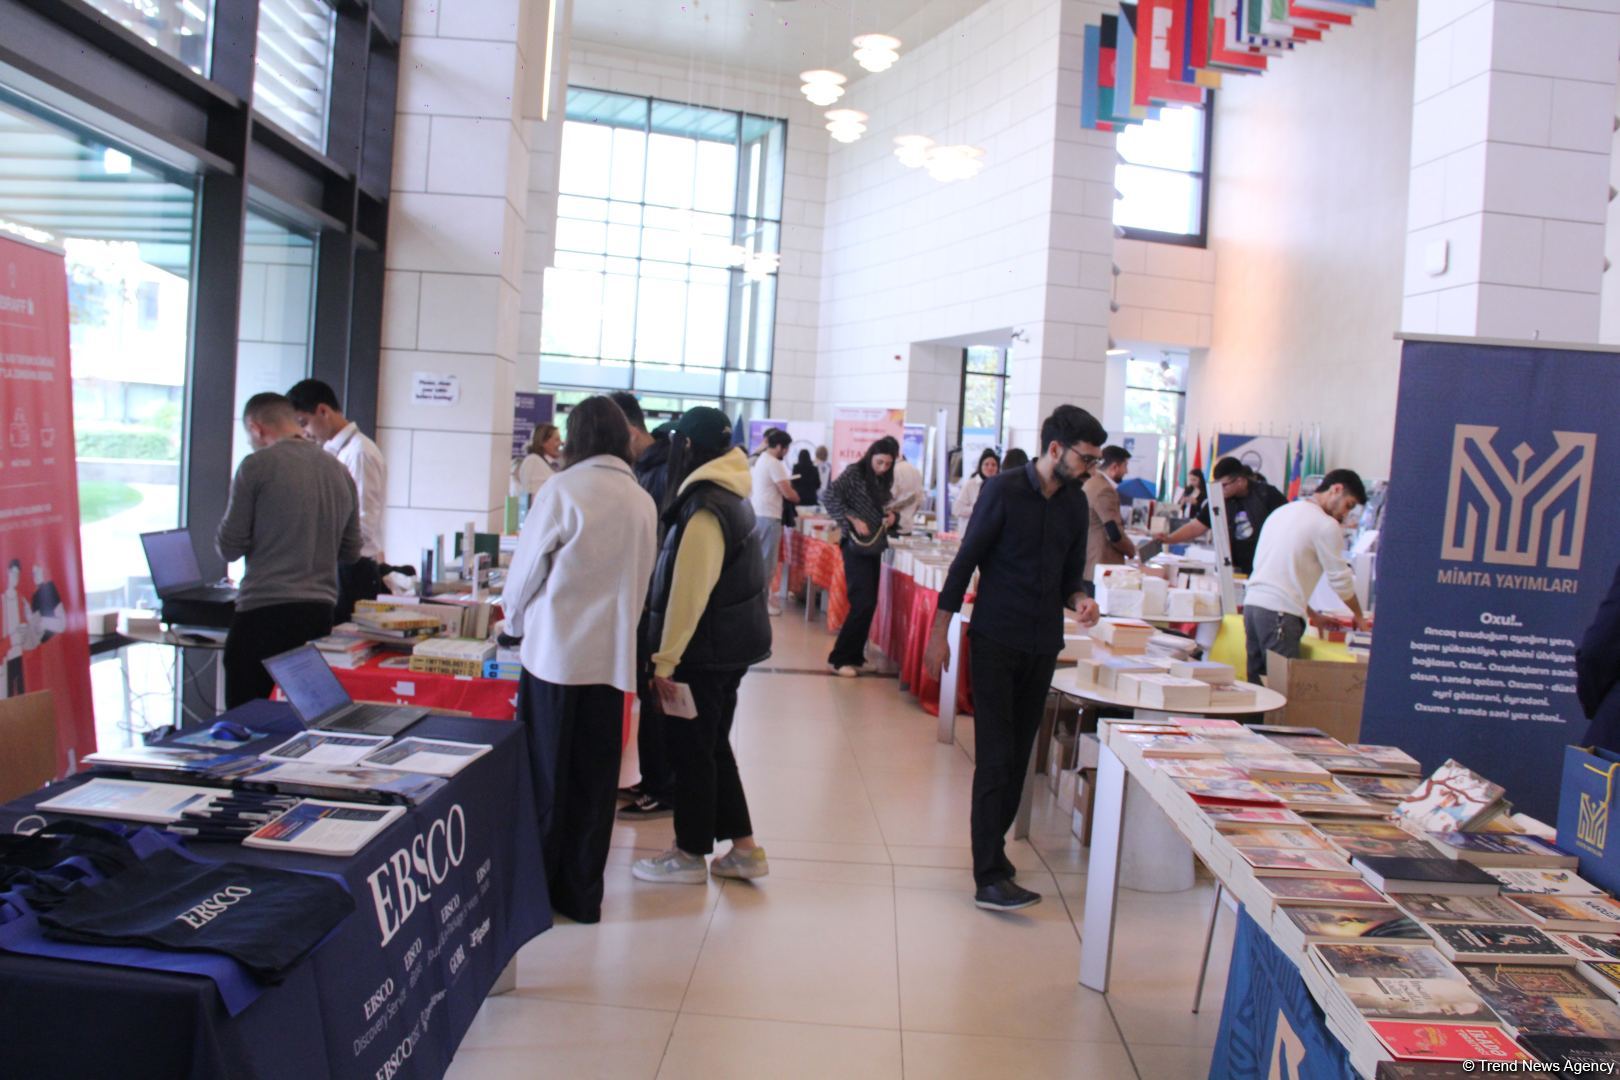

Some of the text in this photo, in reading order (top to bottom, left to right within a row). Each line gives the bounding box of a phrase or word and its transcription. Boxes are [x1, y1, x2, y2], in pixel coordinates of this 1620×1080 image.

[1437, 567, 1578, 594] MİMTA YAYIMLARI
[1410, 641, 1440, 653] başını
[1424, 627, 1456, 639] Ancaq
[1458, 630, 1508, 642] oxuduğun
[1442, 675, 1472, 685] səndə
[1508, 680, 1544, 690] Oxuma
[1414, 703, 1450, 714] Oxuma
[1457, 706, 1488, 716] səndə
[1489, 709, 1509, 718] səni
[1511, 712, 1530, 721] yox
[366, 804, 466, 948] EBSCO
[175, 886, 252, 929] EBSCO
[363, 977, 395, 1022] EBSCO
[353, 1013, 388, 1057] Discovery
